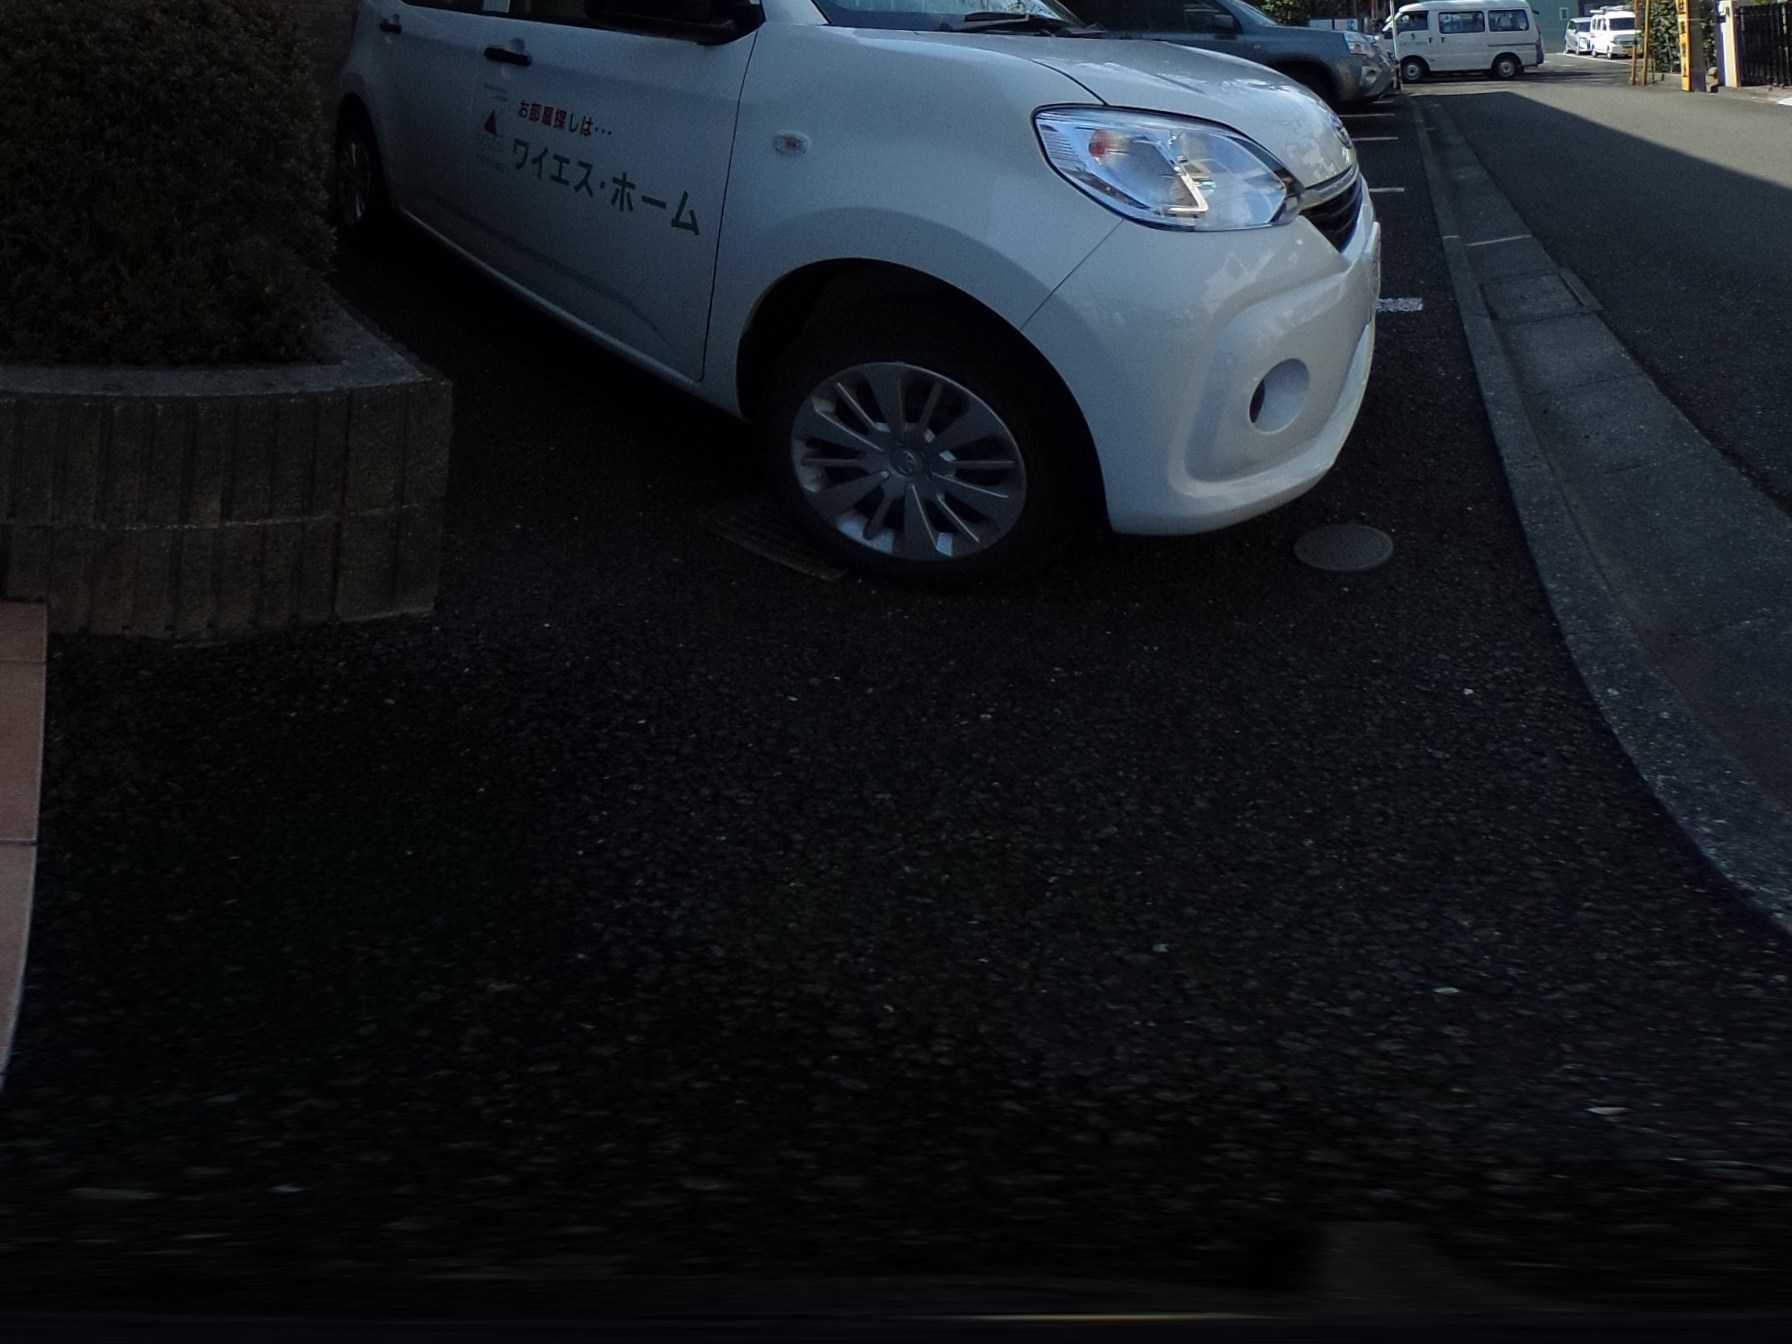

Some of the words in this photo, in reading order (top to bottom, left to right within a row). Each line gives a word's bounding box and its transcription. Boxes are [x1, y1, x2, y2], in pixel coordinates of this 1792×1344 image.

[512, 137, 700, 236] ワイエス・ホーム
